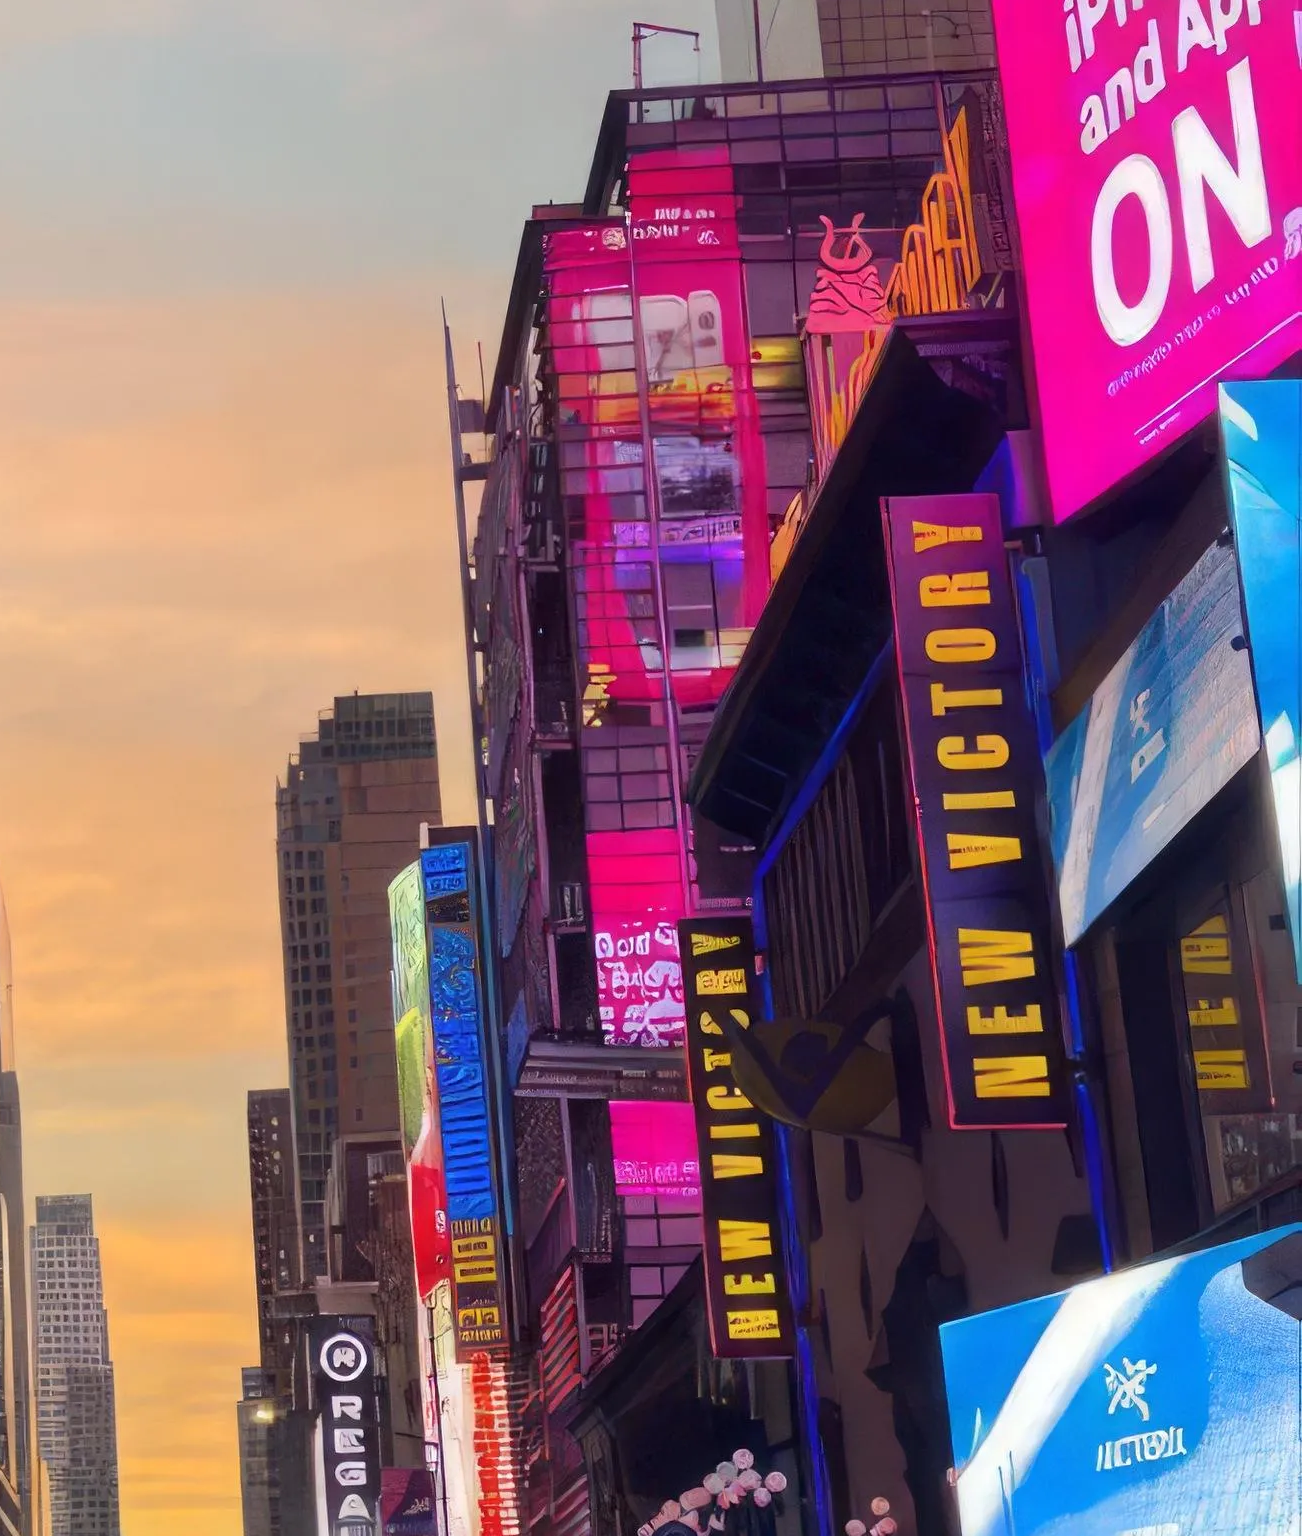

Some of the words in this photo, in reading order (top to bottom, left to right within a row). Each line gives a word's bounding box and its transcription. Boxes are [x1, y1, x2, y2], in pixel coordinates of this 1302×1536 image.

[1080, 18, 1166, 155] and
[1090, 55, 1273, 348] ON
[911, 519, 1023, 869] VICTORY
[956, 927, 1052, 1099] NEW
